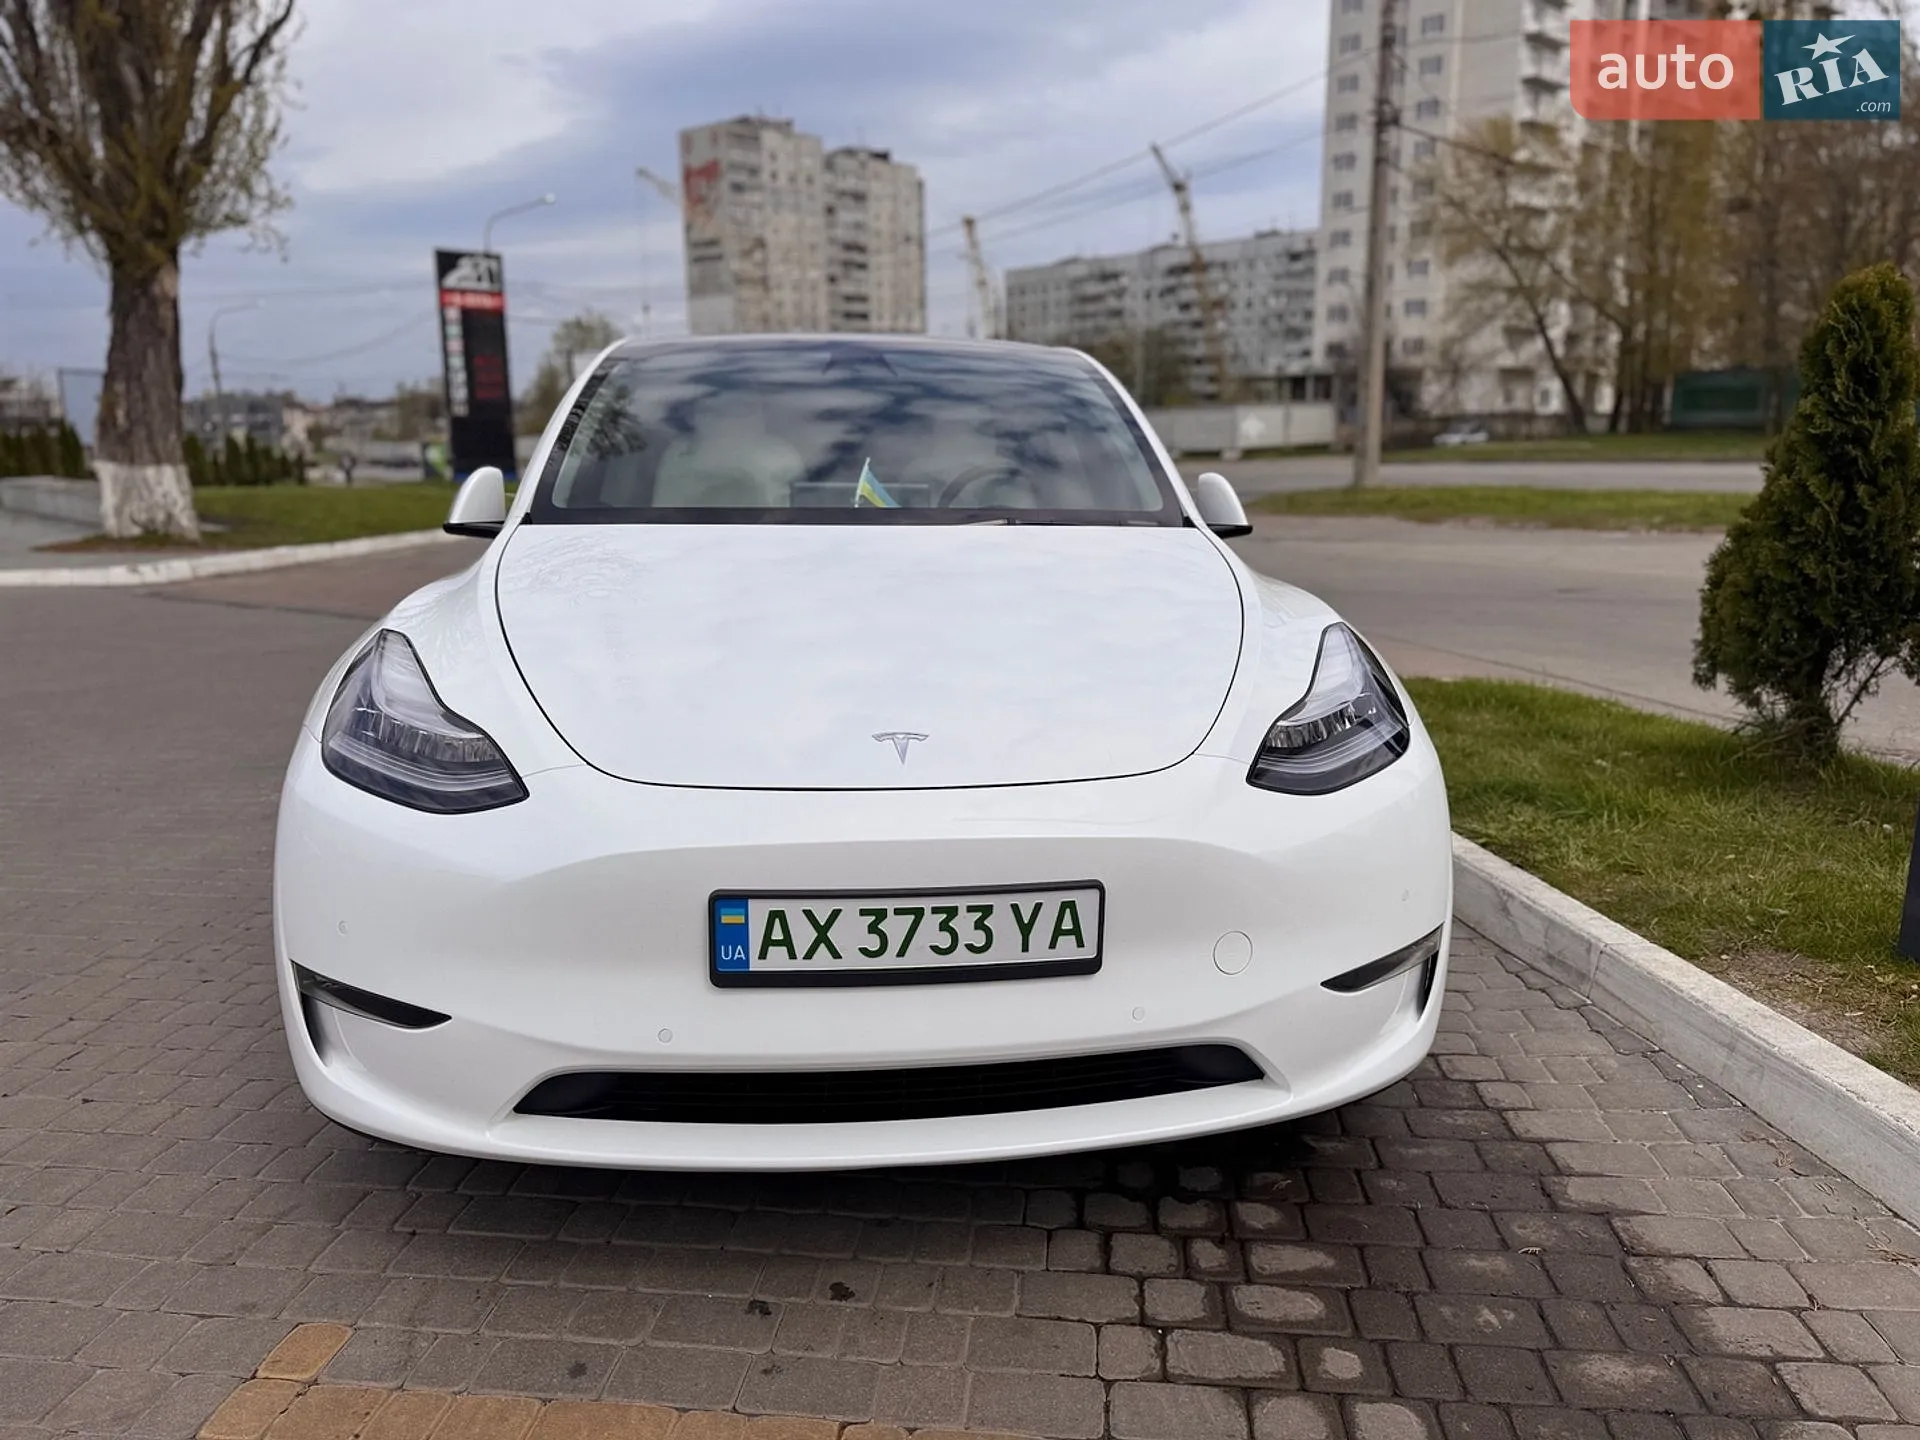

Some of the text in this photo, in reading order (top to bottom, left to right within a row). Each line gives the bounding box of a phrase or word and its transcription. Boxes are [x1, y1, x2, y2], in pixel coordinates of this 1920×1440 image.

[757, 900, 1085, 960] AX 3733 YA
[720, 945, 746, 960] UA
